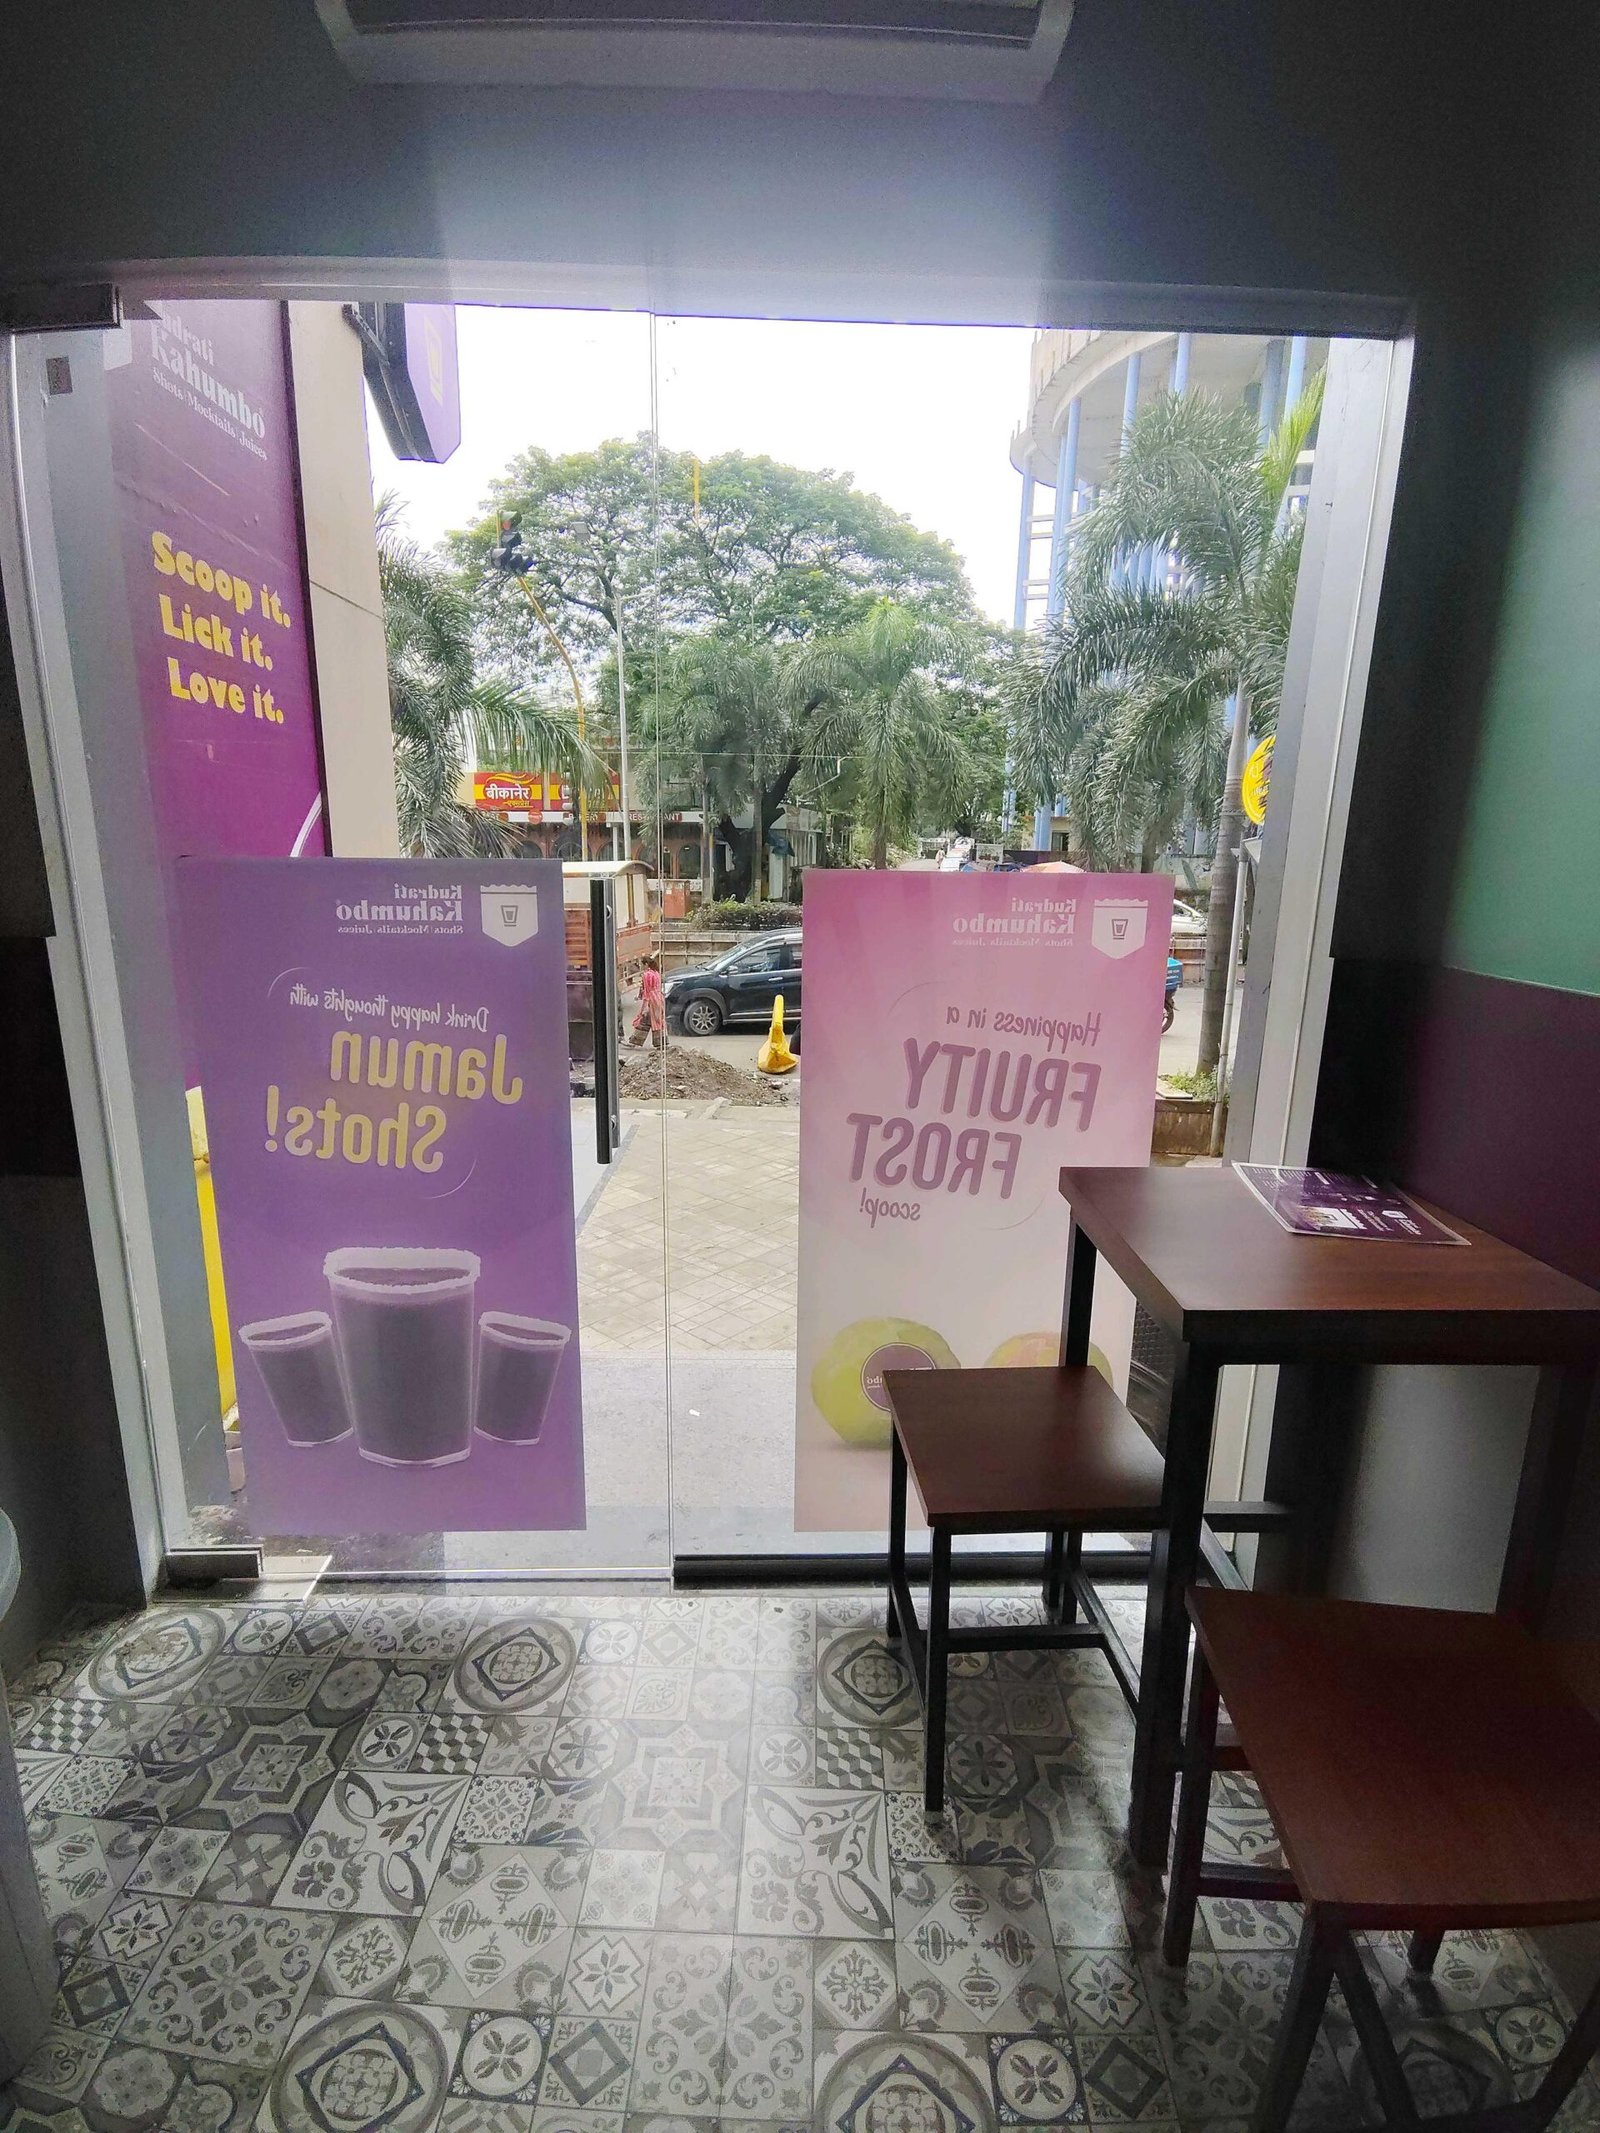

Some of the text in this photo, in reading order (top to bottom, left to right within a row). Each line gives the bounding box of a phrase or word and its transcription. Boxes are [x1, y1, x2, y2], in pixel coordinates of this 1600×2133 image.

[159, 306, 214, 366] udrati
[151, 321, 266, 438] Kahumbo
[153, 367, 268, 460] Shots Mocktails Juices
[152, 531, 291, 628] Scoop it.
[159, 593, 273, 671] Lick it.
[168, 656, 284, 724] Love it.
[485, 783, 530, 800] बीकानेर
